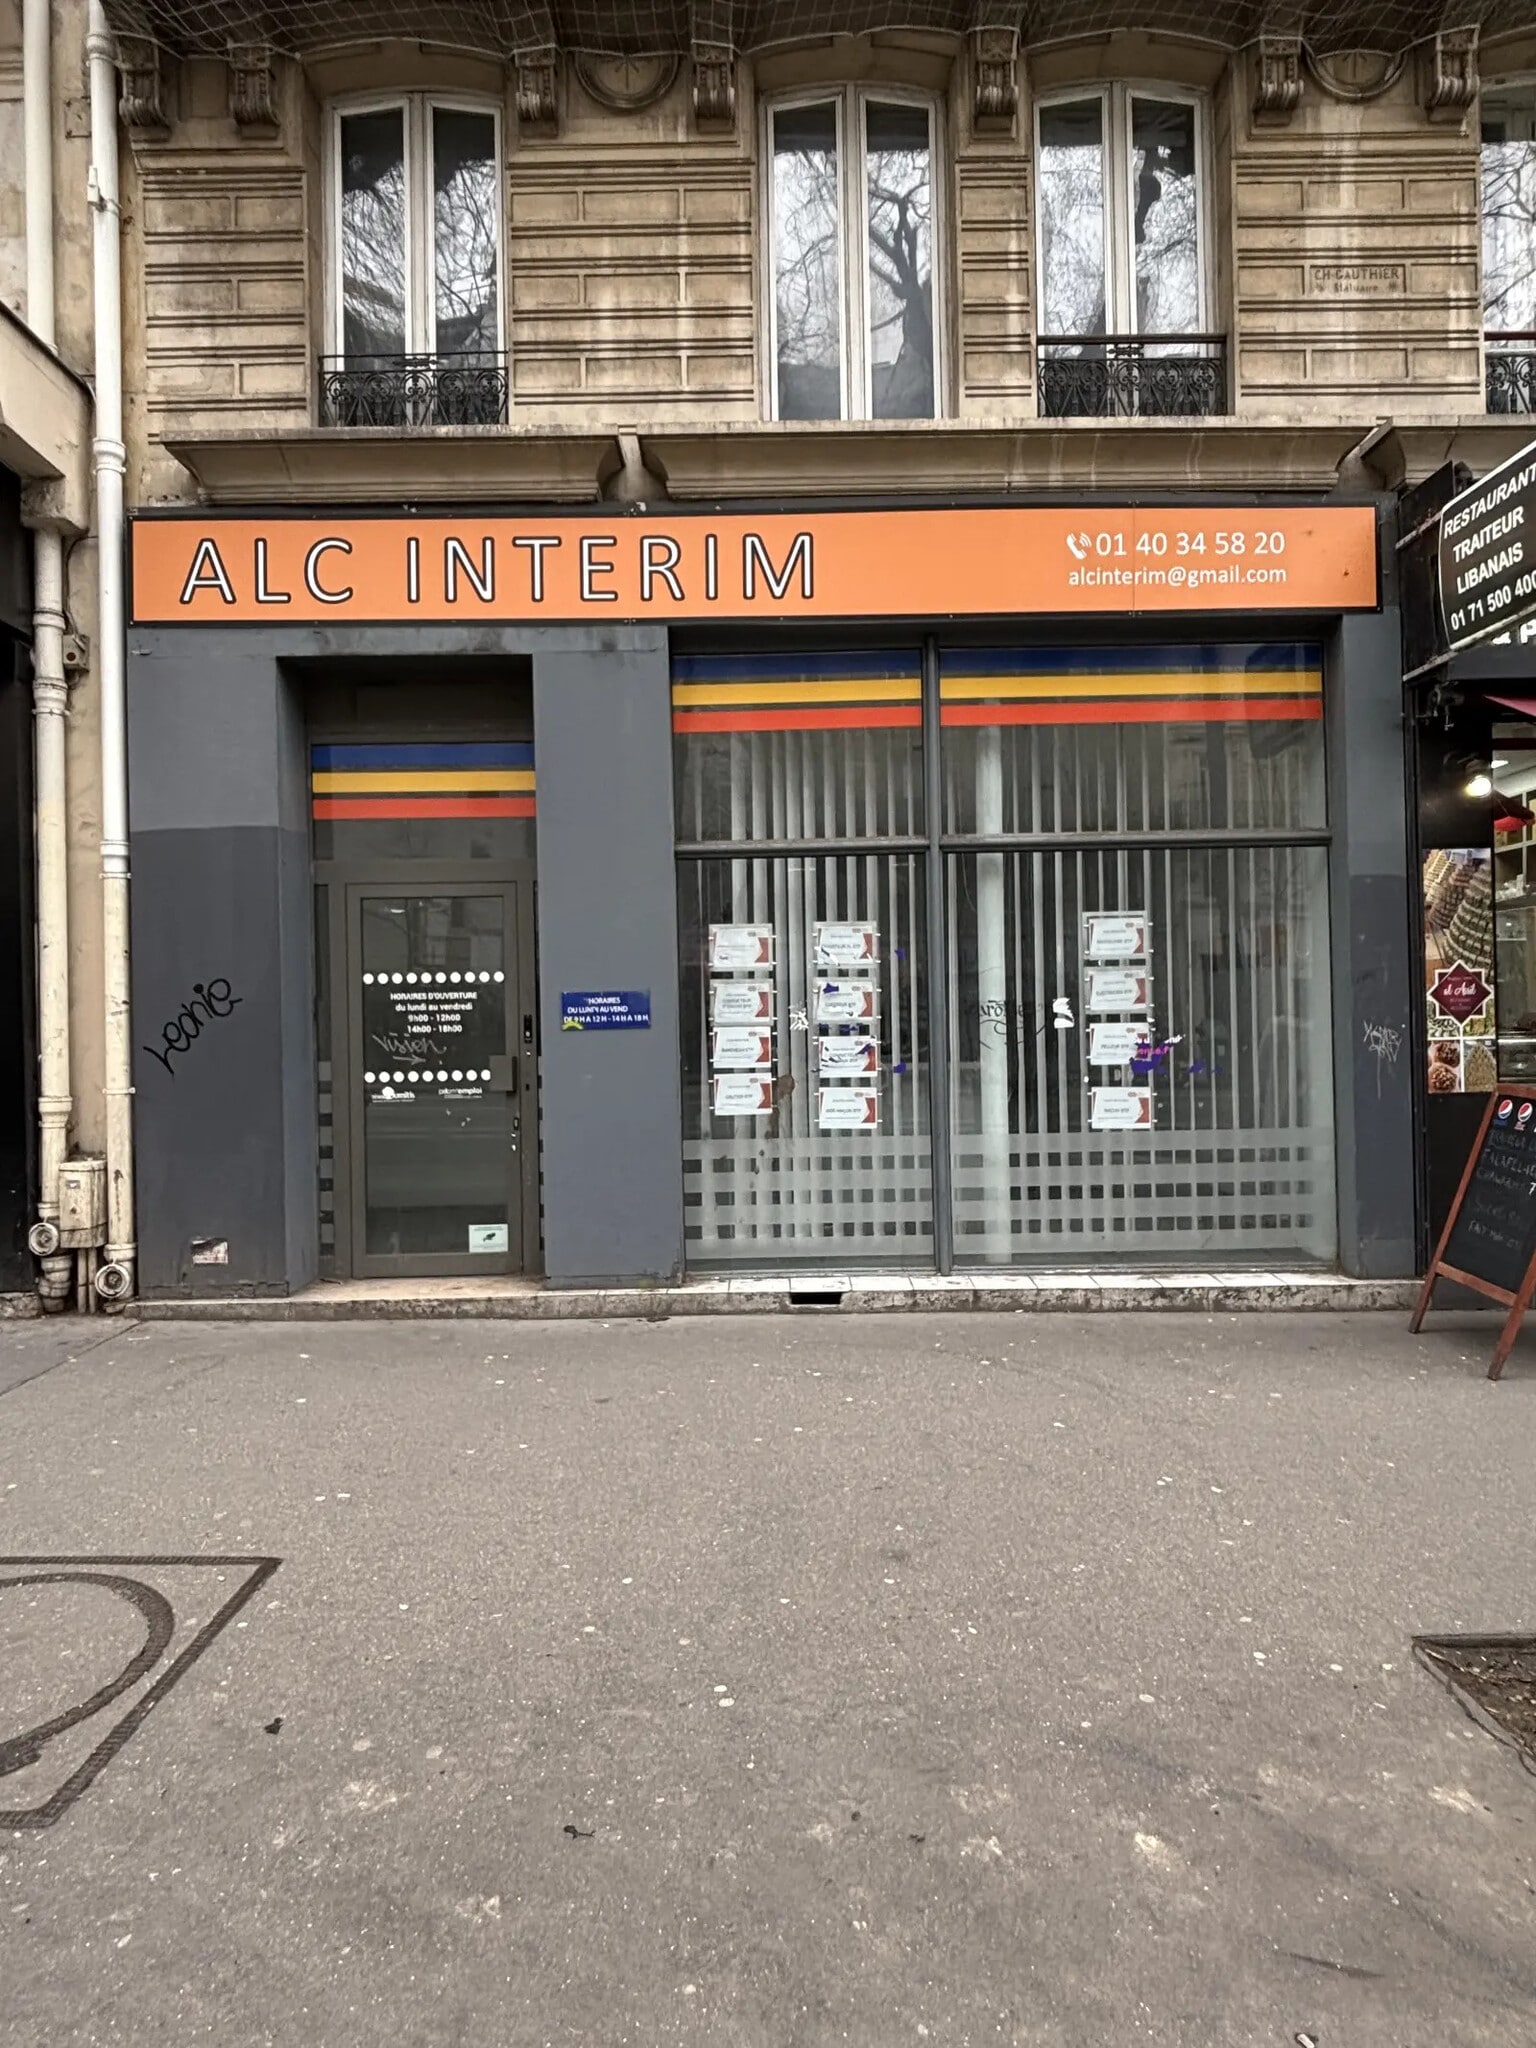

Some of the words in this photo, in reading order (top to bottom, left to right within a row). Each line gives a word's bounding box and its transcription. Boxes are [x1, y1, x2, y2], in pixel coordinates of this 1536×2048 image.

[1443, 463, 1536, 539] RESTAURANT
[1095, 533, 1127, 556] 01
[1136, 532, 1168, 555] 40
[1175, 532, 1207, 555] 34
[1215, 531, 1246, 554] 58
[1254, 531, 1285, 554] 20
[1453, 505, 1525, 563] TRAITEUR
[180, 537, 354, 605] ALC
[406, 532, 815, 603] INTERIM
[1069, 564, 1287, 588] alcinterim@gmail.com
[1456, 542, 1524, 595] LIBANAIS
[1451, 608, 1466, 630] 01
[1467, 599, 1484, 622] 71
[1487, 585, 1511, 612] 500
[390, 992, 427, 1000] HORAIRES
[428, 991, 478, 1000] D'OUVERTURE
[395, 1003, 406, 1011] du
[407, 1003, 427, 1011] lundi
[439, 1002, 473, 1010] vendredi
[407, 1025, 432, 1033] 14h00
[438, 1025, 463, 1033] 18h00
[408, 1014, 429, 1022] 9h00
[436, 1013, 461, 1022] 12h00
